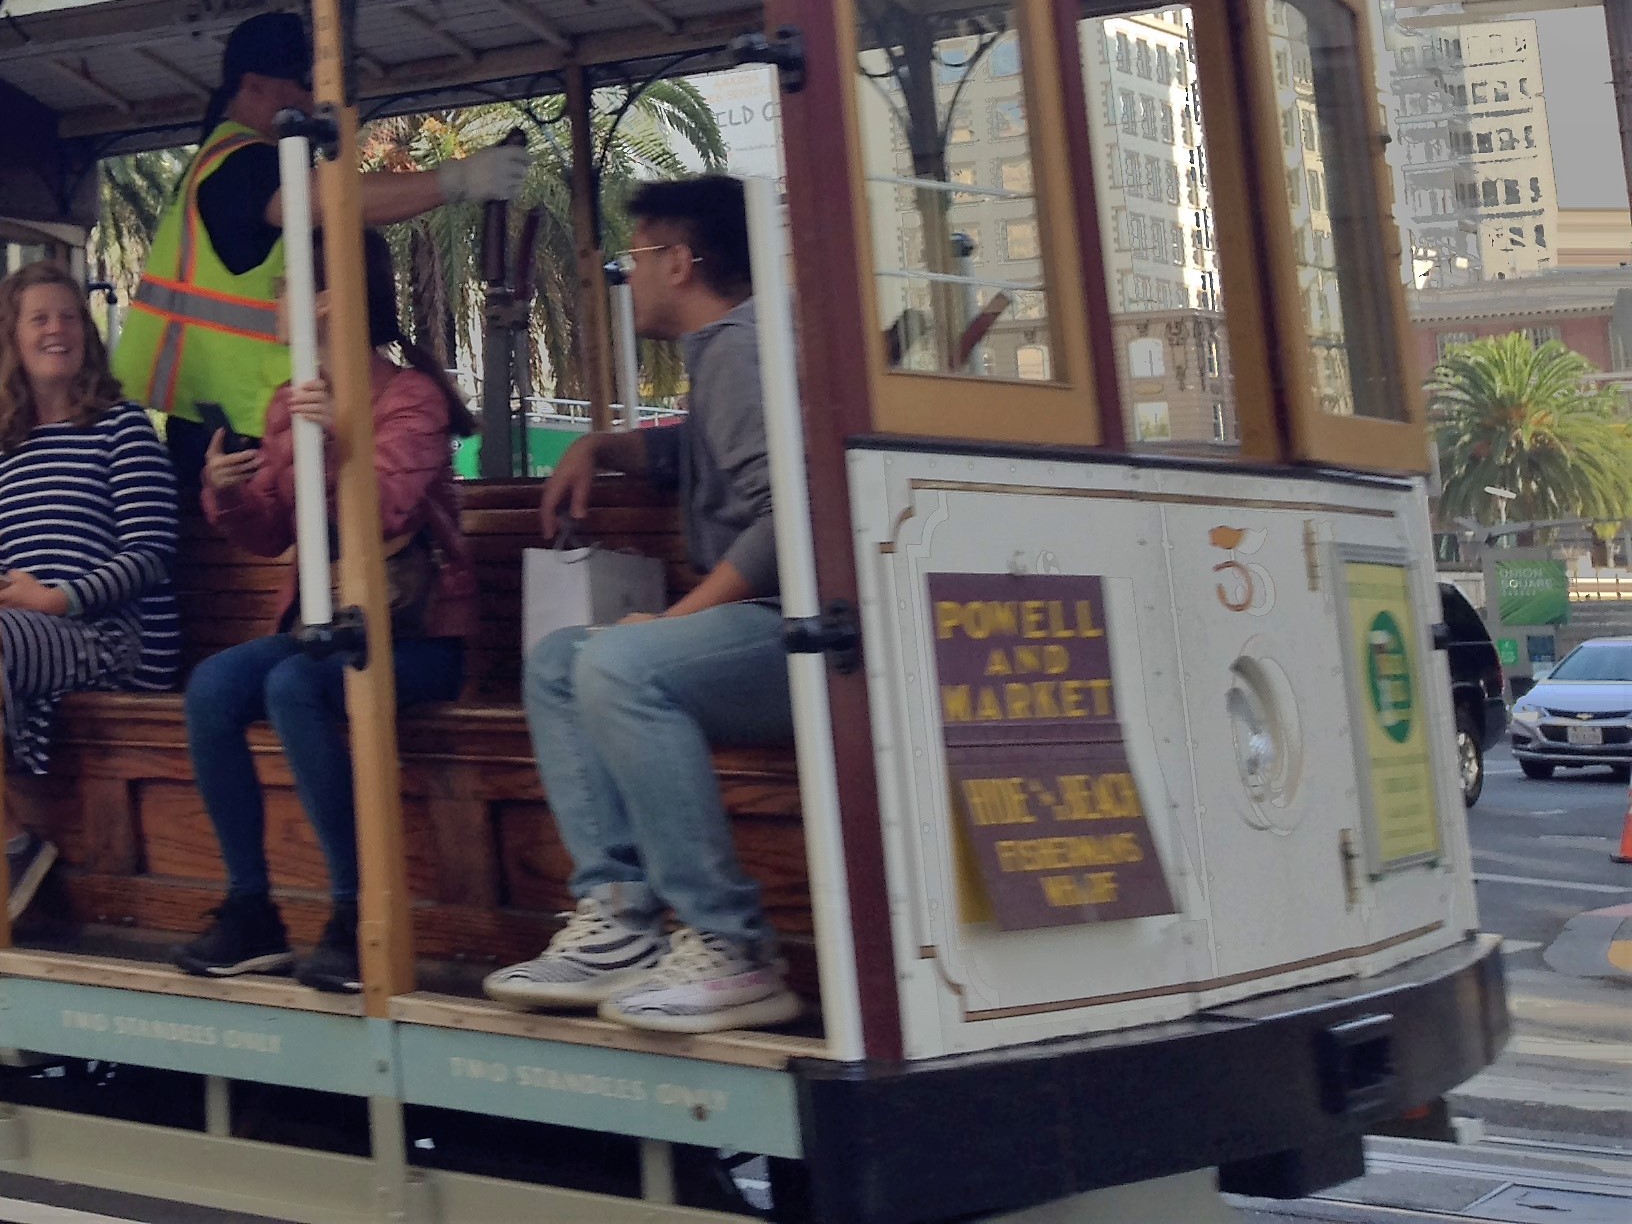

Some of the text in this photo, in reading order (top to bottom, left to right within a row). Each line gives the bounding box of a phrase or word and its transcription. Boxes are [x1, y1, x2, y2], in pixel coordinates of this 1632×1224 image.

[934, 599, 1106, 640] POWELL
[984, 644, 1071, 676] AND
[940, 678, 1113, 722] MARKET
